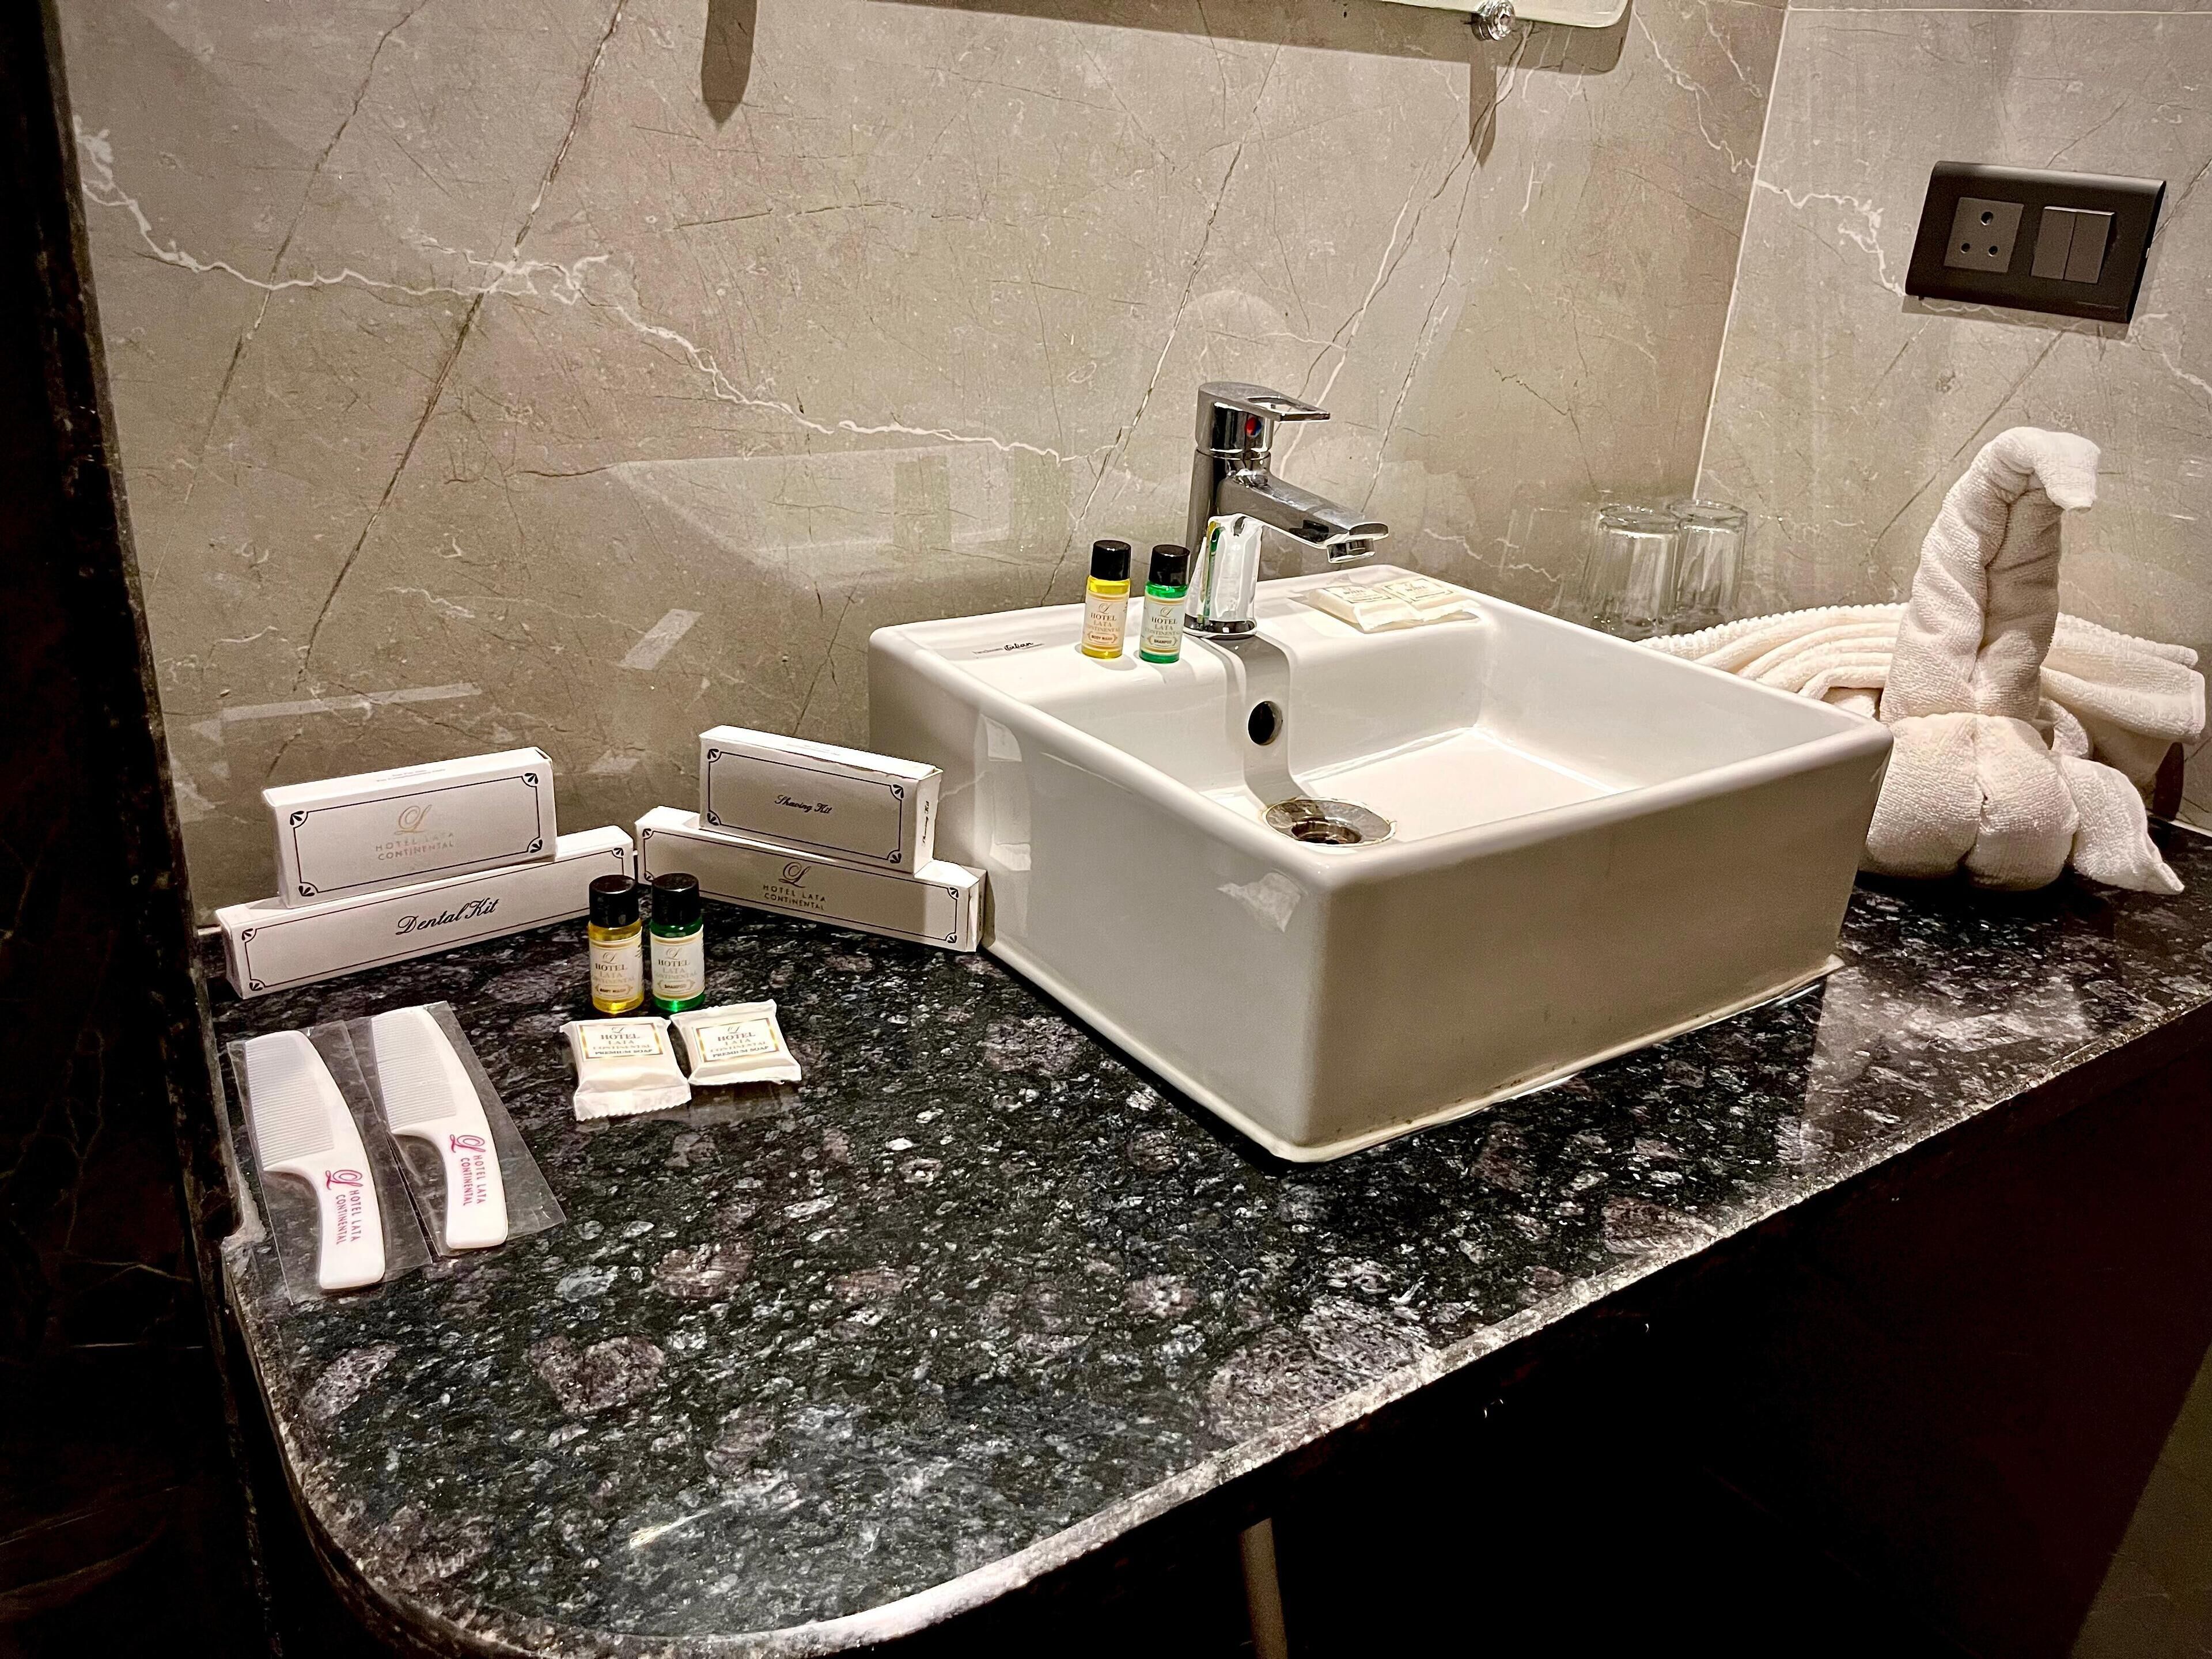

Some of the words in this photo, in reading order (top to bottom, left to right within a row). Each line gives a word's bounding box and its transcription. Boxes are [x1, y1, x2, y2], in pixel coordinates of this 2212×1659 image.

[1090, 612, 1116, 622] HOTEL
[1152, 616, 1177, 624] HOTEL
[774, 794, 813, 813] Shaving
[814, 802, 832, 814] Kit
[375, 837, 418, 851] HOTEL
[378, 840, 454, 861] CONTINENTAL
[763, 884, 796, 897] HOTEL
[802, 891, 826, 903] LATA
[764, 892, 825, 911] CONTINENTAL
[395, 902, 471, 935] Dental
[464, 897, 500, 919] Kit
[595, 963, 628, 971] HOTEL
[658, 959, 691, 967] HOTEL
[718, 1032, 756, 1041] HOTEL
[713, 1048, 748, 1058] PREMIUM
[473, 1154, 486, 1180] HOTEL
[460, 1157, 474, 1206] CONTINENTAL
[349, 1189, 362, 1217] HOTEL
[477, 1183, 487, 1205] LATA
[336, 1194, 348, 1245] CONTINENTAL
[350, 1219, 362, 1243] LATA
